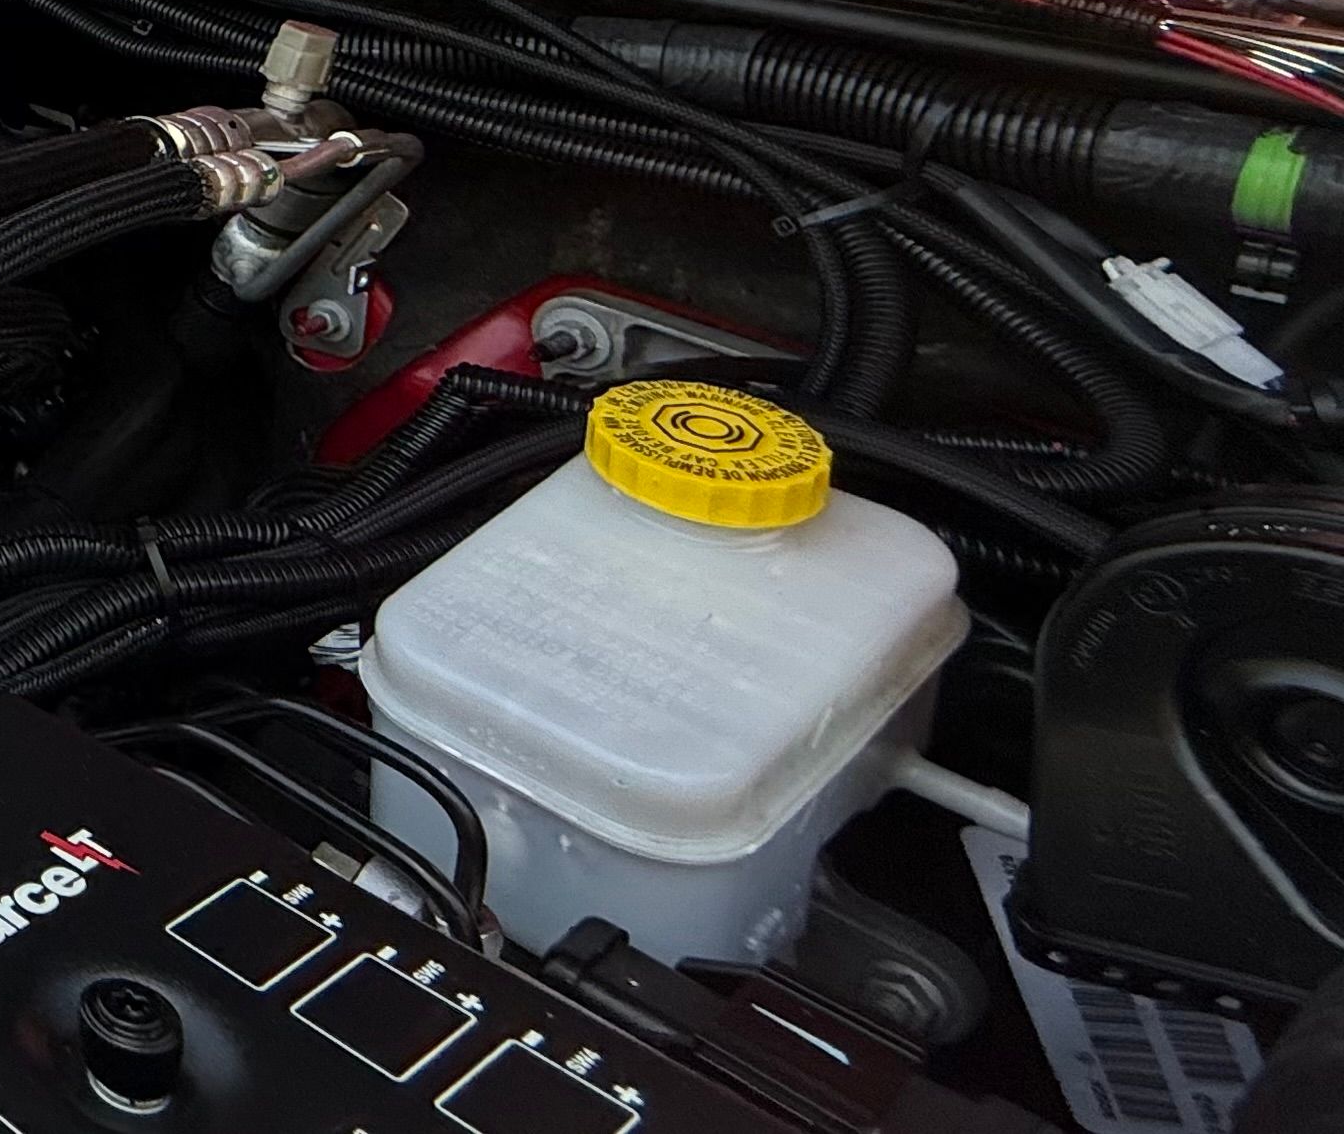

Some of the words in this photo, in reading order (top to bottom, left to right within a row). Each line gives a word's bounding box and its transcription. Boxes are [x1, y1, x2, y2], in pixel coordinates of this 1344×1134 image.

[684, 390, 765, 416] WARNING
[613, 432, 717, 479] REMPLISSAGE
[679, 452, 719, 468] CAP
[718, 468, 745, 482] DE
[412, 960, 446, 984] SW5
[565, 1046, 603, 1076] SW4
